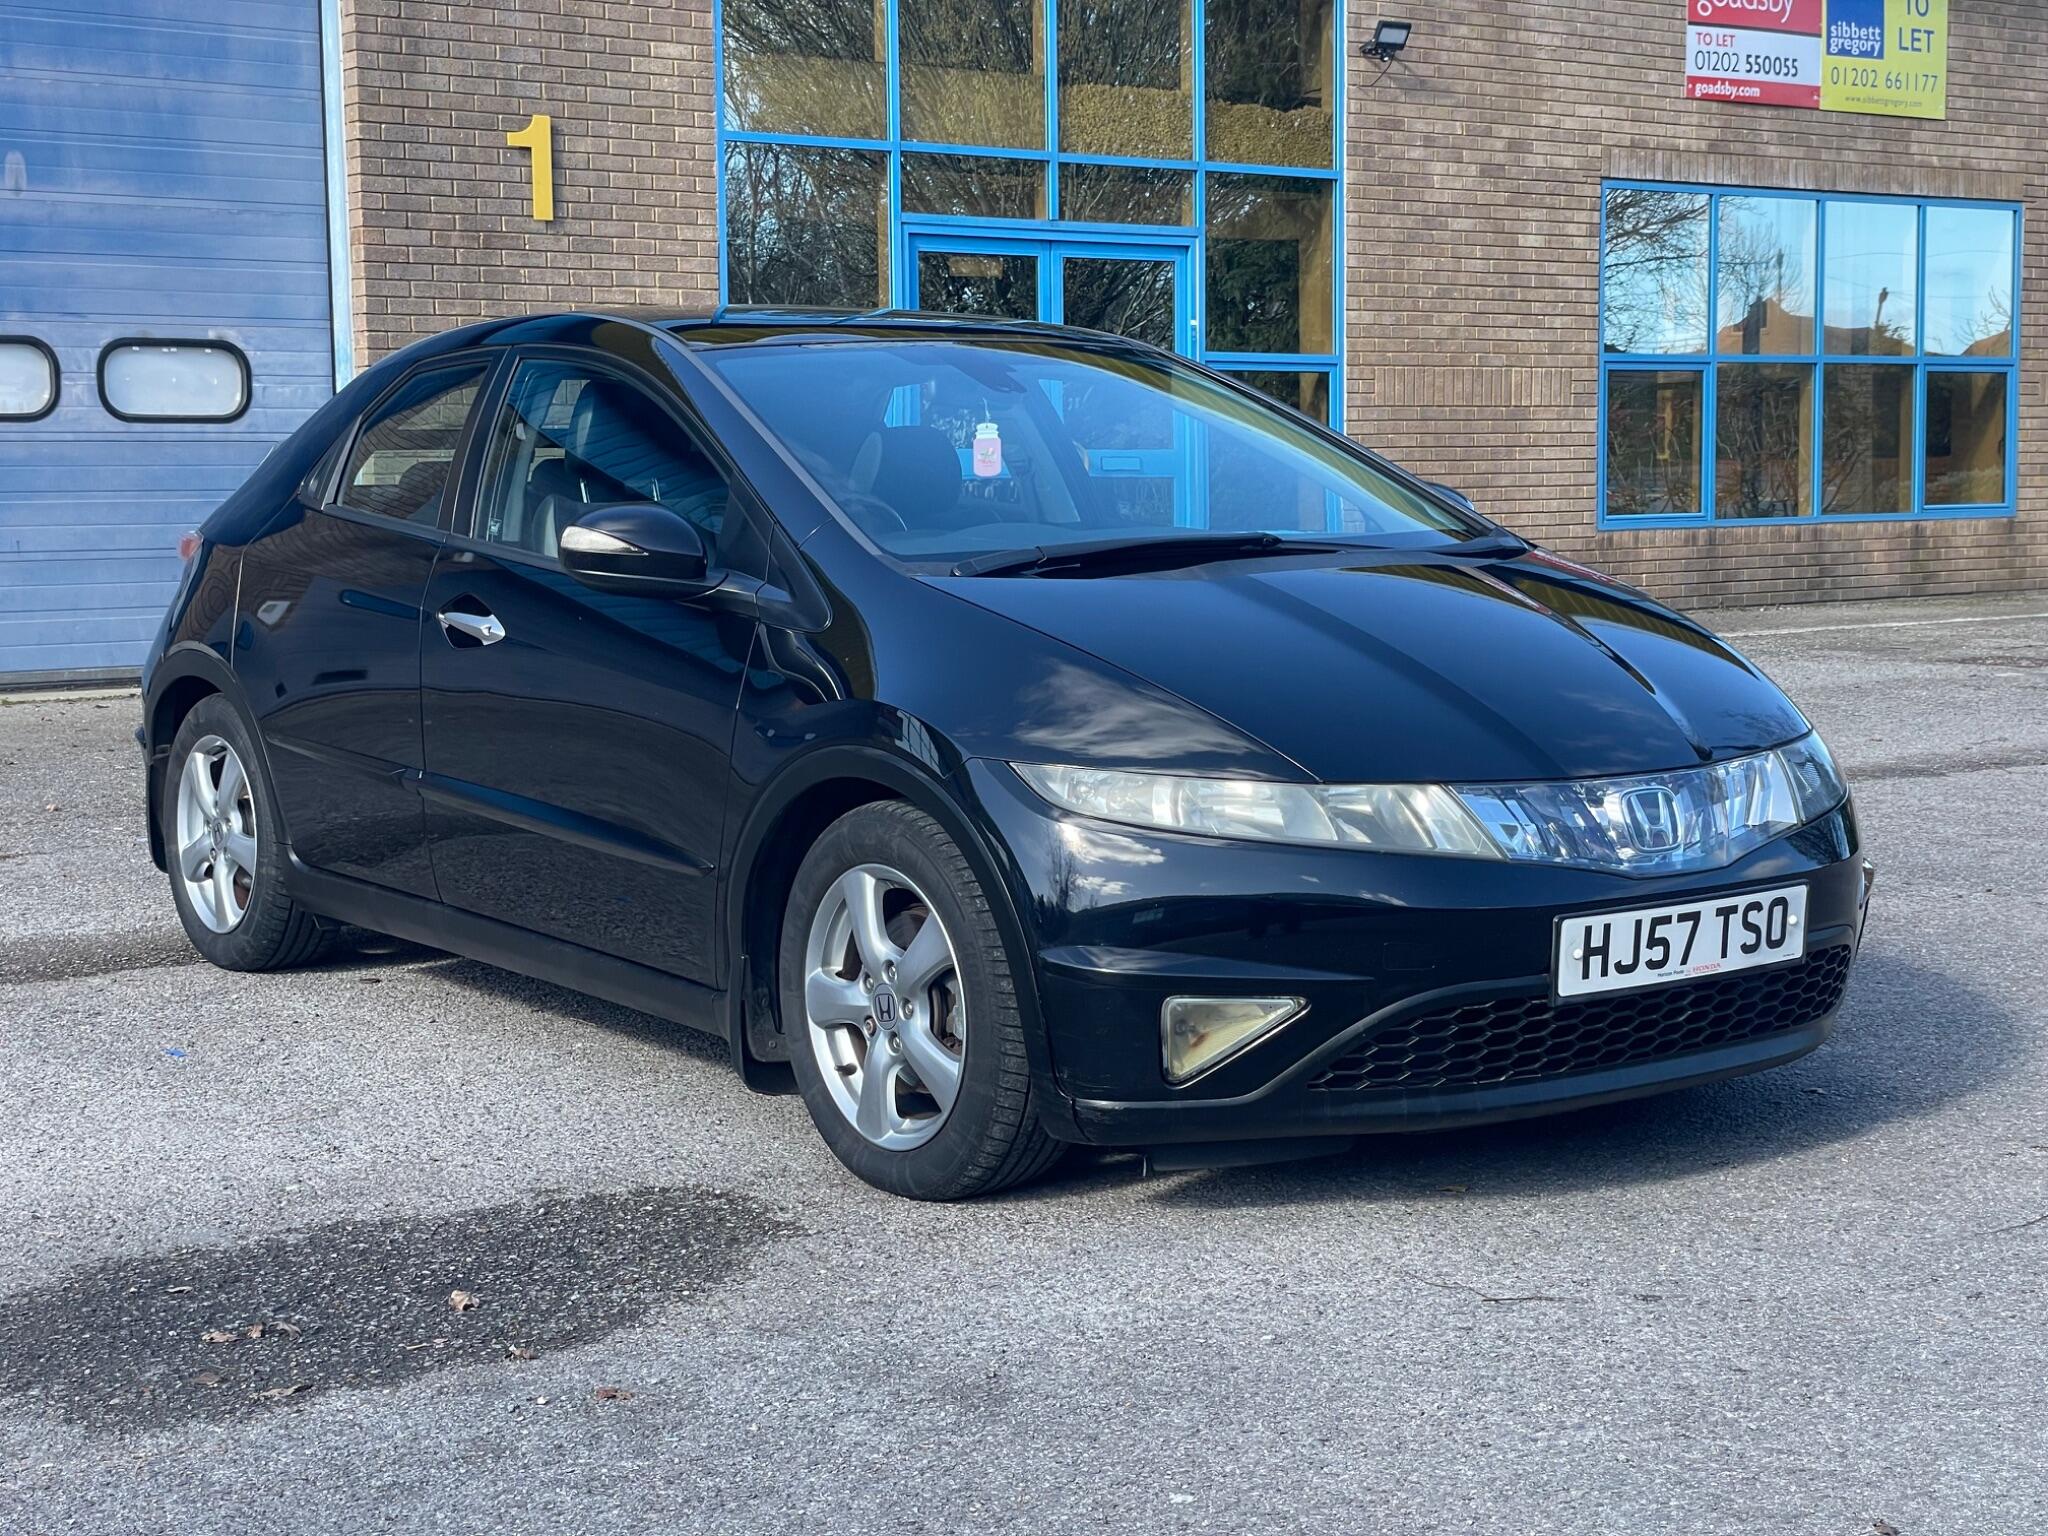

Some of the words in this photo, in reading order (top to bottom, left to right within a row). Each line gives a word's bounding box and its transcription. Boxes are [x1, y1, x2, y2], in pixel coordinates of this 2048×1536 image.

[1696, 32, 1713, 46] TO
[1716, 34, 1735, 48] LET
[1830, 21, 1880, 40] sibbett
[1899, 27, 1934, 53] LET
[1830, 37, 1880, 56] gregory
[1694, 50, 1740, 73] 01202
[1745, 54, 1798, 77] 550055
[1695, 80, 1760, 100] goadsby.com
[1831, 66, 1878, 88] 01202
[1885, 71, 1938, 93] 661177
[506, 114, 553, 221] 1
[1581, 910, 1702, 980] HJ57
[1715, 896, 1789, 960] TSO
